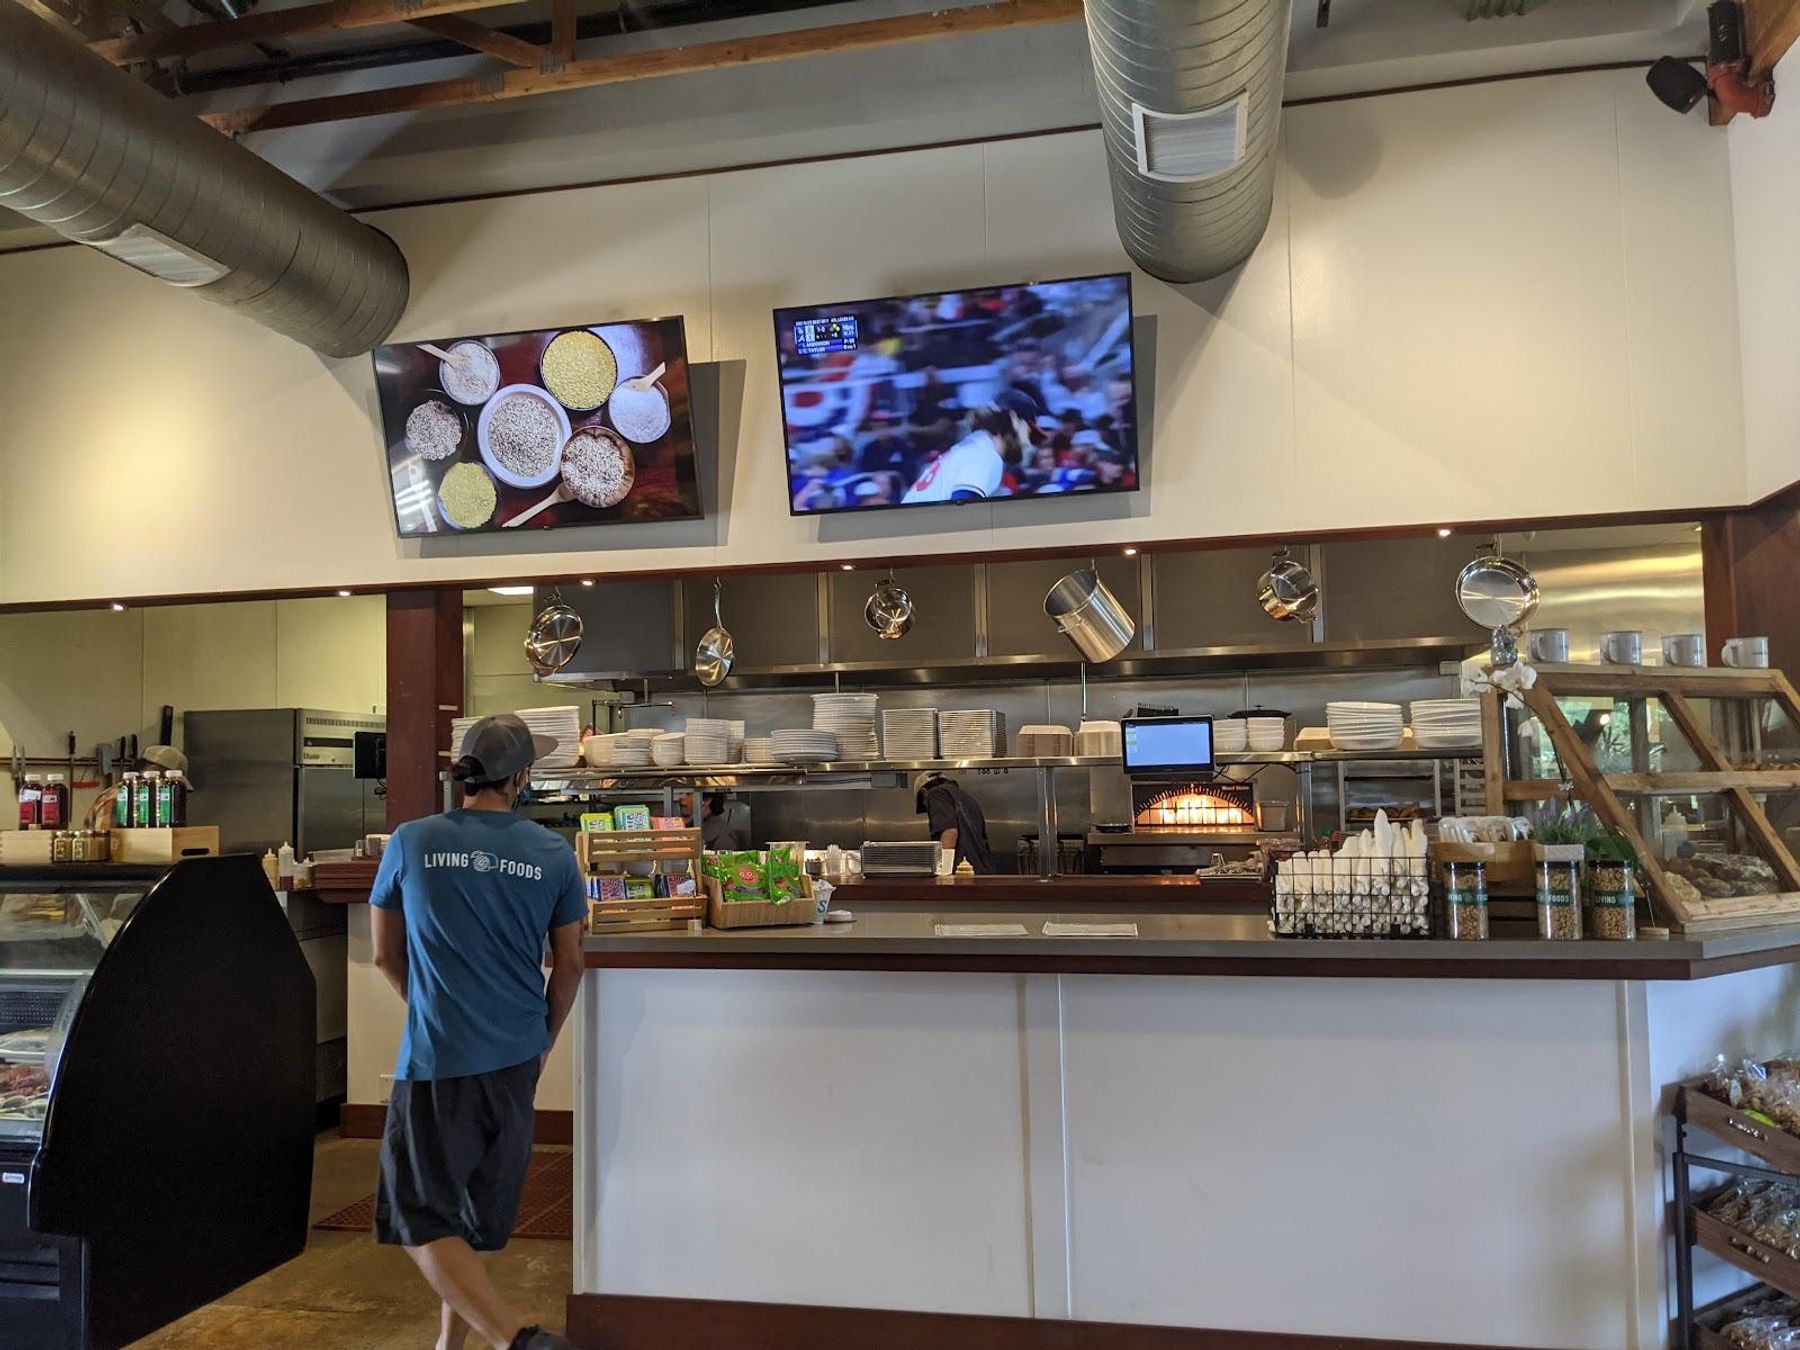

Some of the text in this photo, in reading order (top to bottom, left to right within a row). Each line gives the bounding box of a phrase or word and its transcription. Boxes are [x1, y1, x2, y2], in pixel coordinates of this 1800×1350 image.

[424, 852, 543, 881] LIVING FOODS
[1548, 894, 1570, 903] FOODS
[1595, 895, 1617, 904] LIVING
